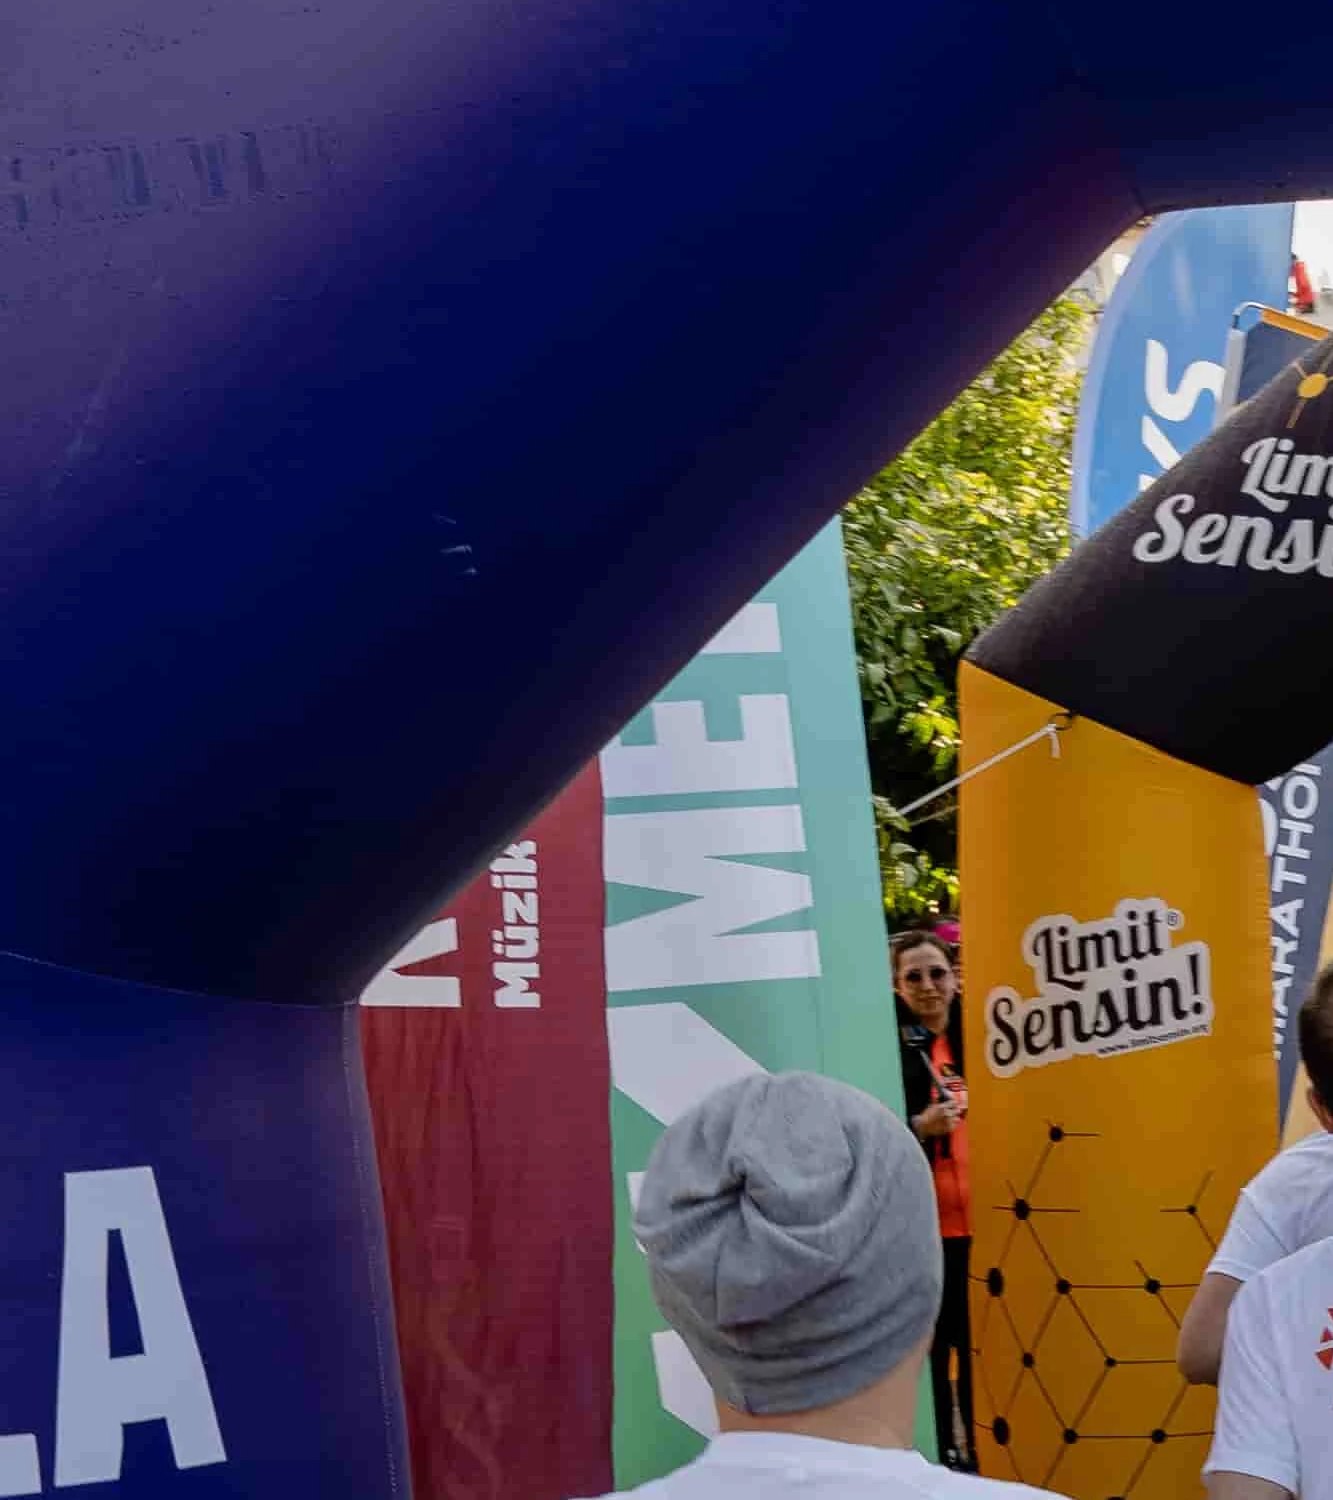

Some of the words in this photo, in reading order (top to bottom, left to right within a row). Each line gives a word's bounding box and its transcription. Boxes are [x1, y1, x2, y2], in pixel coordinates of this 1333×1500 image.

[488, 839, 541, 1008] Müzik
[1032, 910, 1164, 990] Limit
[993, 953, 1204, 1066] Sensin!
